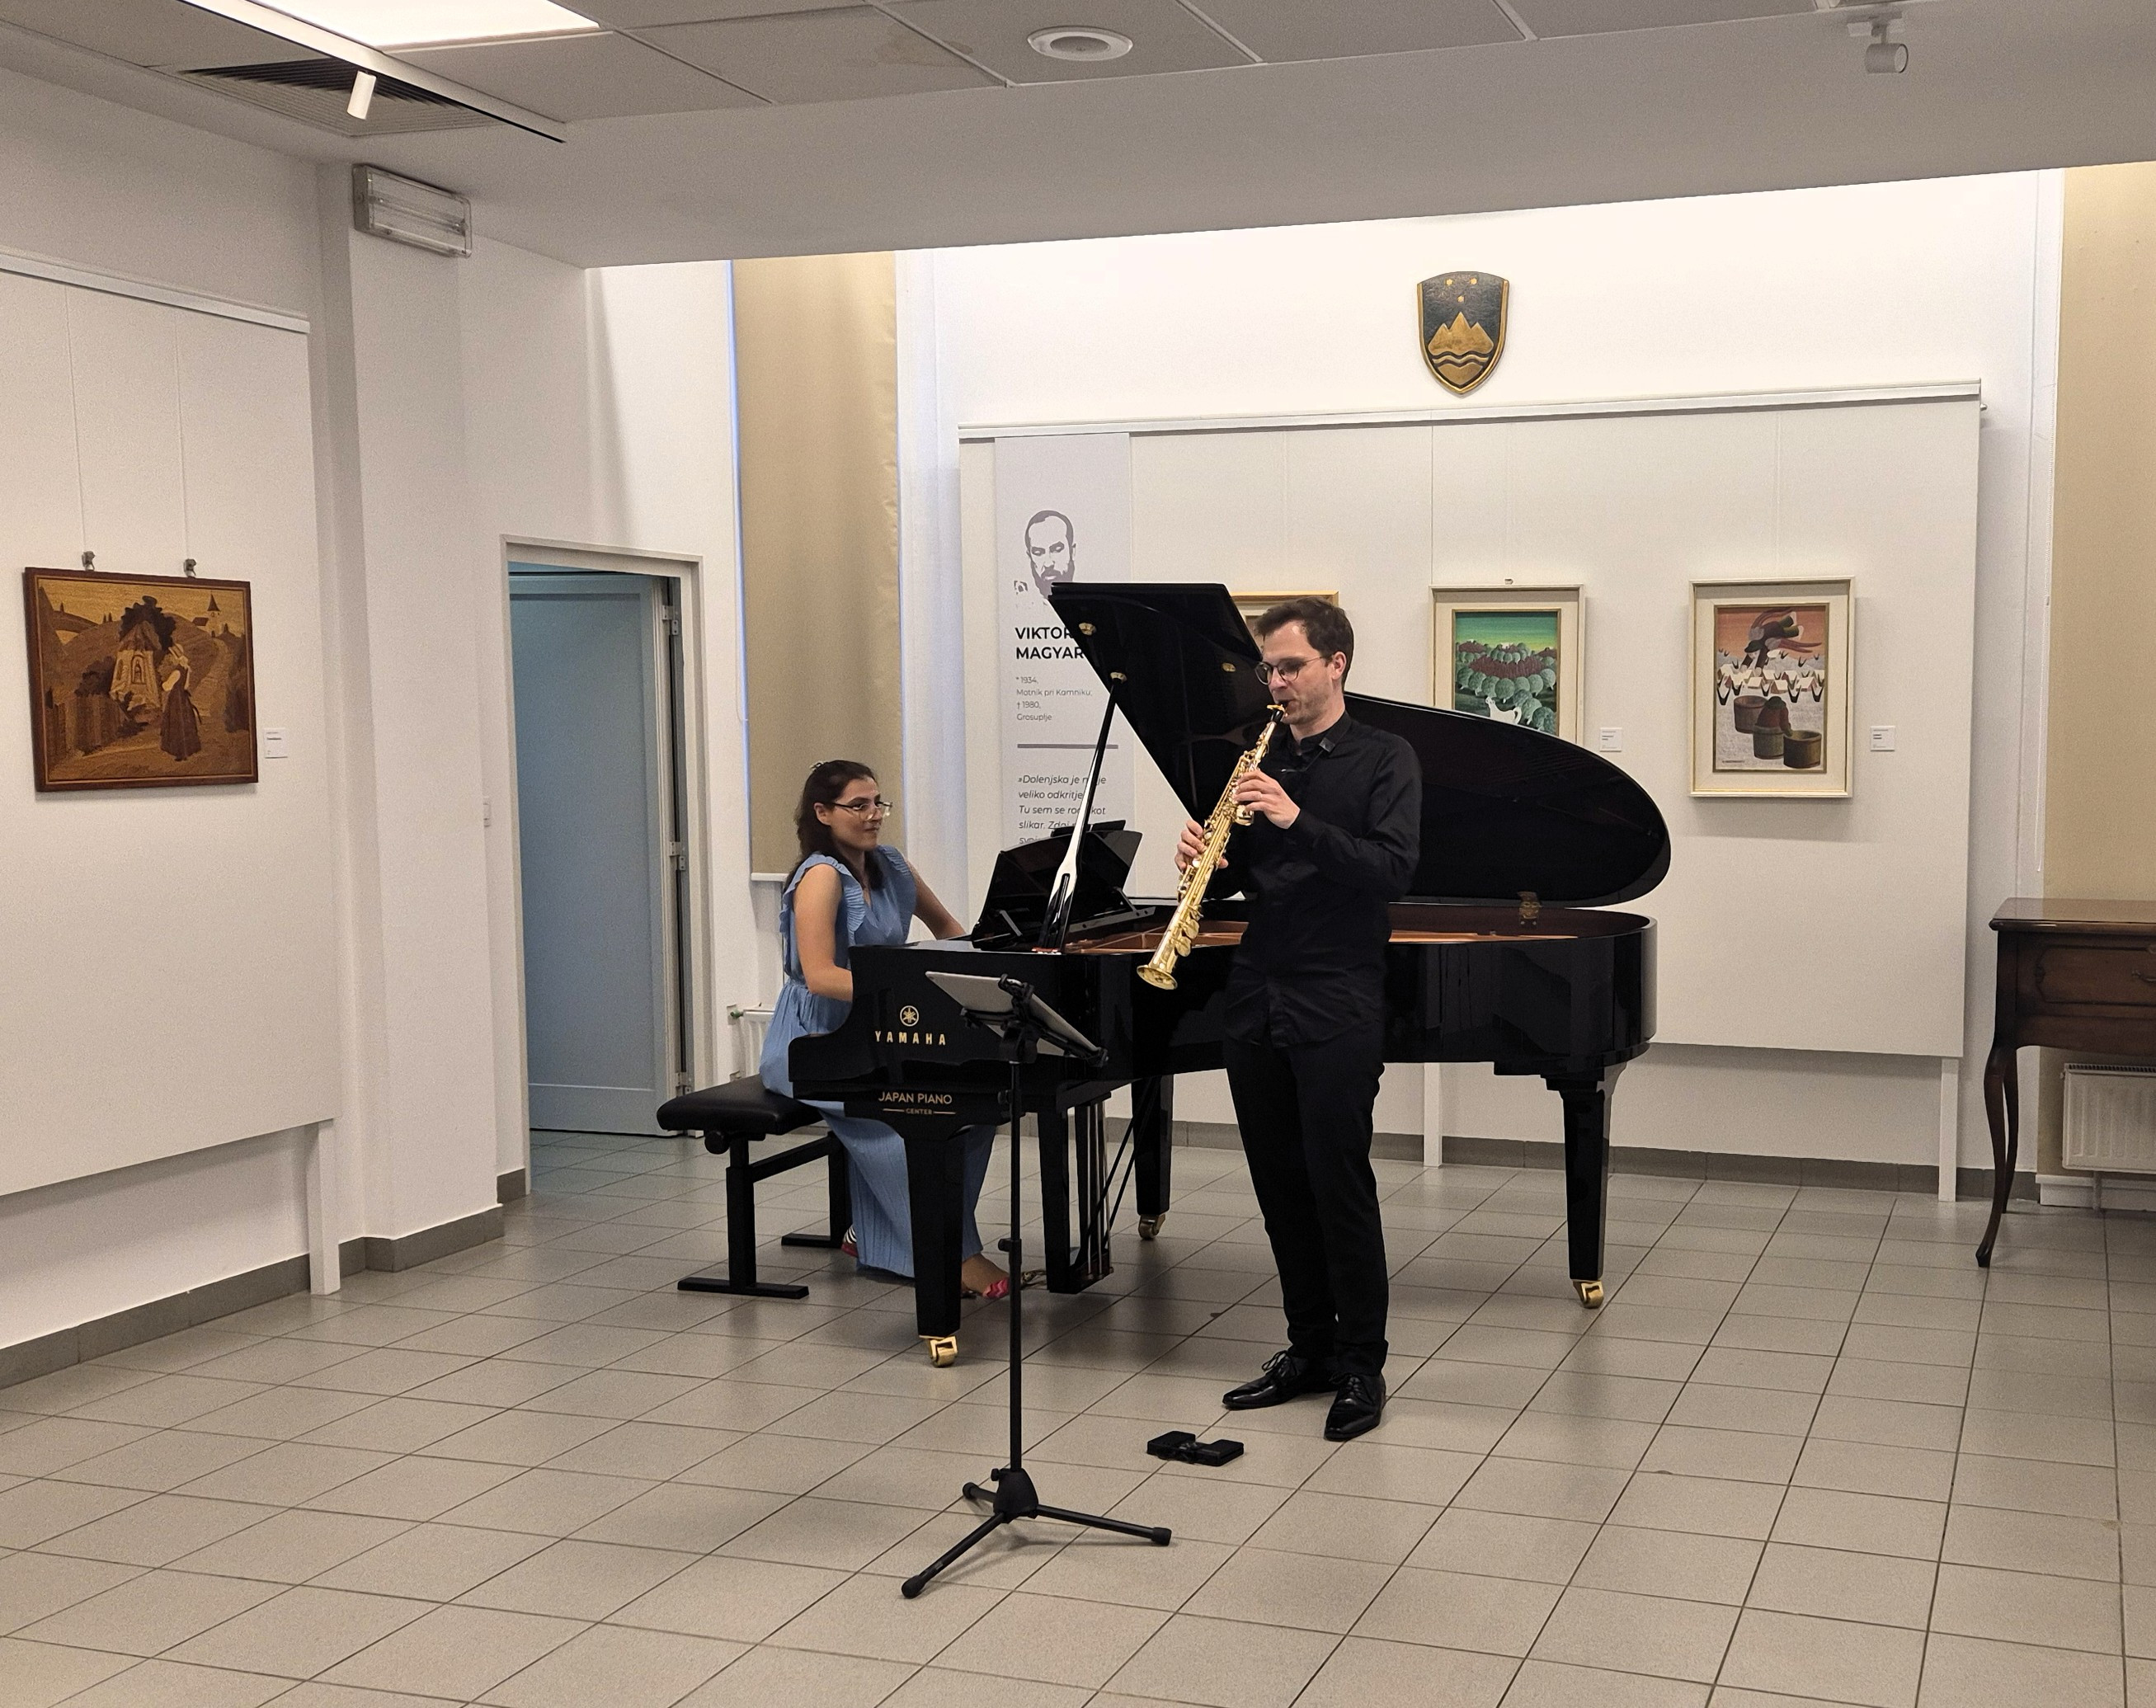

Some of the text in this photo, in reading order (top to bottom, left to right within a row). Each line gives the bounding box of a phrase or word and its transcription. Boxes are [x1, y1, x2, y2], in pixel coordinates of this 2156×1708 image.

[1015, 627, 1073, 639] VIKTOR
[1016, 647, 1084, 659] MAGYAR
[1044, 689, 1054, 697] pri
[1016, 713, 1052, 722] Grosuplje
[1070, 776, 1080, 785] je
[1019, 790, 1045, 799] veliko
[1019, 805, 1030, 814] Tu
[1091, 806, 1106, 815] kot
[875, 1031, 946, 1046] YAMAHA
[878, 1091, 953, 1104] JAPAN PIANO
